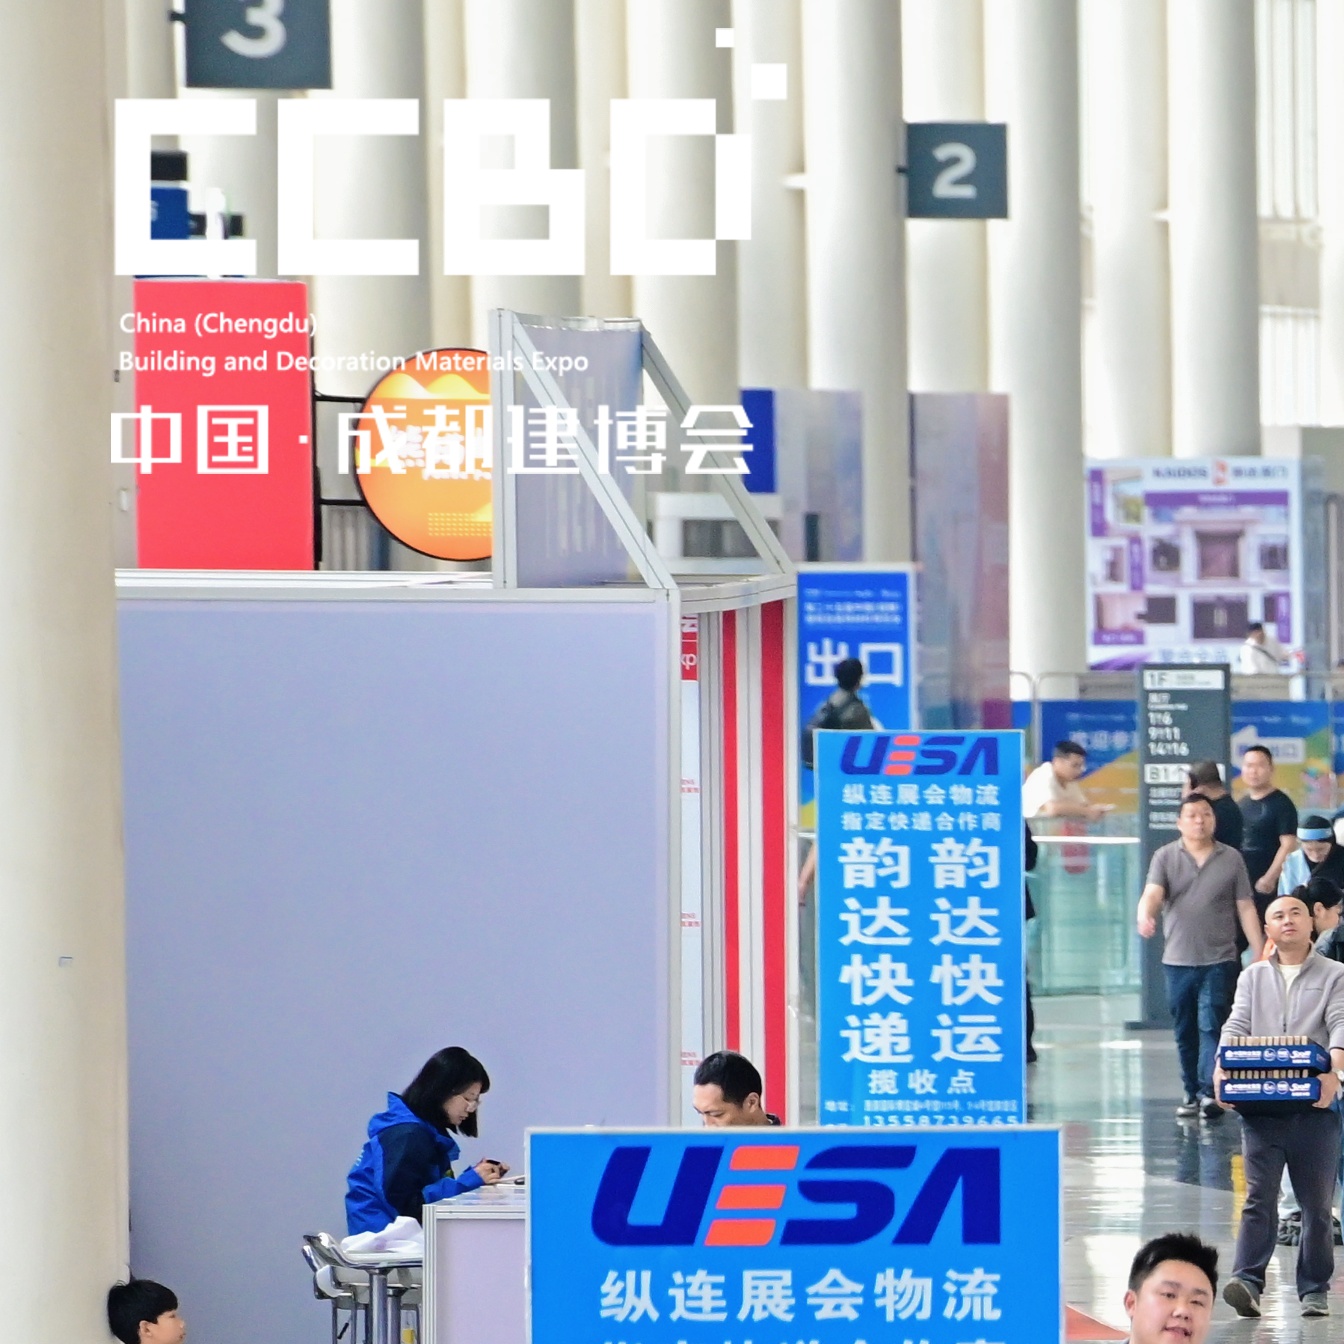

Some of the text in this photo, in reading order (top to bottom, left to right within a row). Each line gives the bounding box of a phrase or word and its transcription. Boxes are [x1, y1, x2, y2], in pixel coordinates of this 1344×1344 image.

[932, 142, 977, 198] 2
[804, 636, 905, 687] 出口
[841, 783, 1001, 806] 纵连展会物流
[841, 810, 1002, 831] 指定快递合作商
[838, 836, 915, 1064] 韵达快递
[928, 836, 1005, 1064] 韵达快运
[867, 1068, 977, 1095] 揽收点
[600, 1267, 1002, 1323] 纵连展会物流
